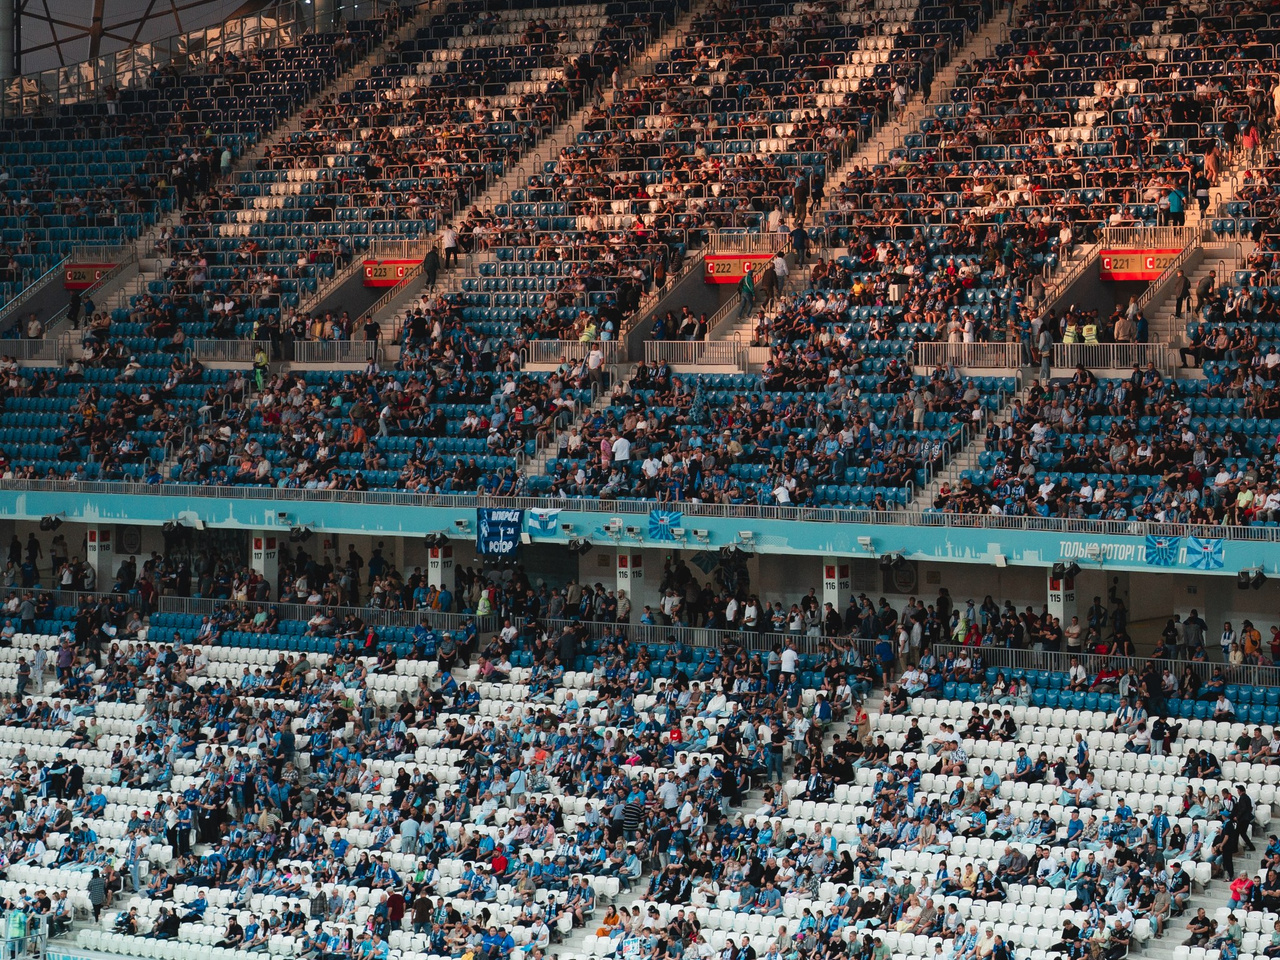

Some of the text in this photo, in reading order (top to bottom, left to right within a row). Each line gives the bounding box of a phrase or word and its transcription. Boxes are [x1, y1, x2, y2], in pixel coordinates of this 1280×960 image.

[716, 263, 732, 273] 222
[1113, 258, 1130, 270] 221
[73, 271, 86, 280] 224
[374, 267, 387, 277] 223
[489, 540, 513, 553] РОТОР
[266, 551, 276, 559] 117
[1101, 543, 1135, 561] РОТОР!
[632, 570, 643, 578] 116
[825, 582, 836, 590] 116
[1050, 594, 1061, 602] 115
[1065, 593, 1075, 601] 115
